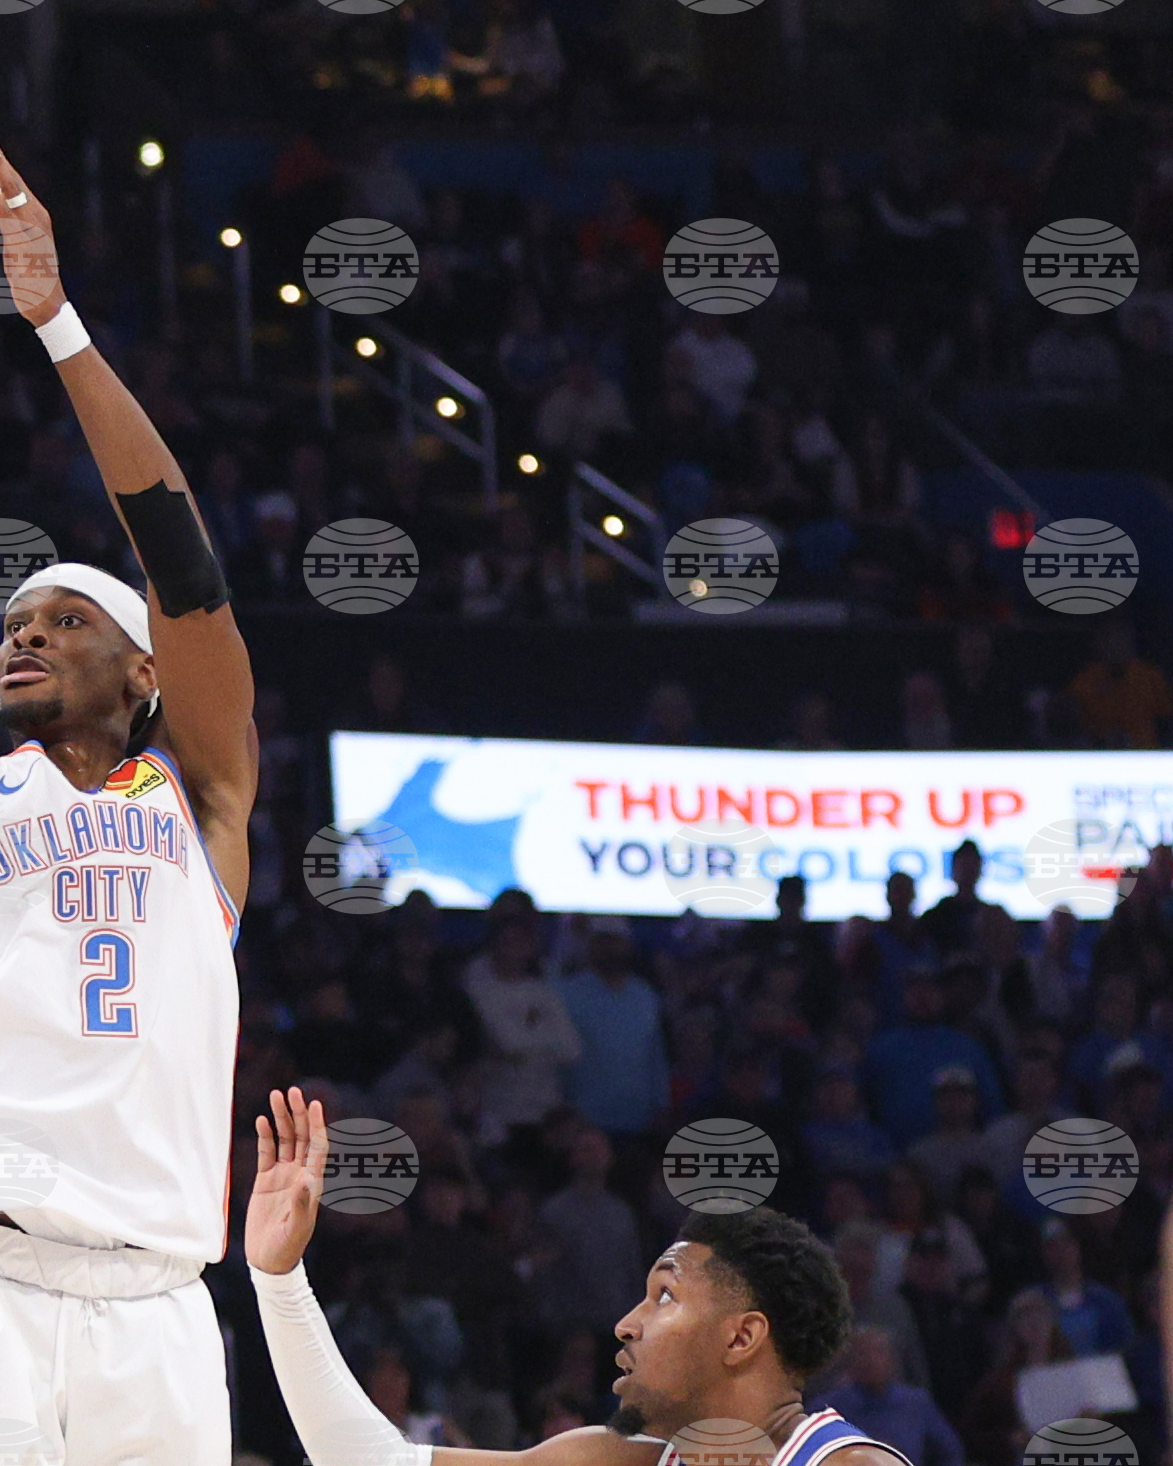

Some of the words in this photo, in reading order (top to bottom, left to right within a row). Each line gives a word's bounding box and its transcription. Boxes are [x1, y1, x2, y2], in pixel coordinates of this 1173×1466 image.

[576, 781, 902, 829] THUNDER
[929, 788, 1024, 829] UP
[579, 839, 737, 879] YOUR
[759, 849, 1025, 884] COLOS
[52, 866, 152, 923] CITY
[80, 928, 139, 1038] 2
